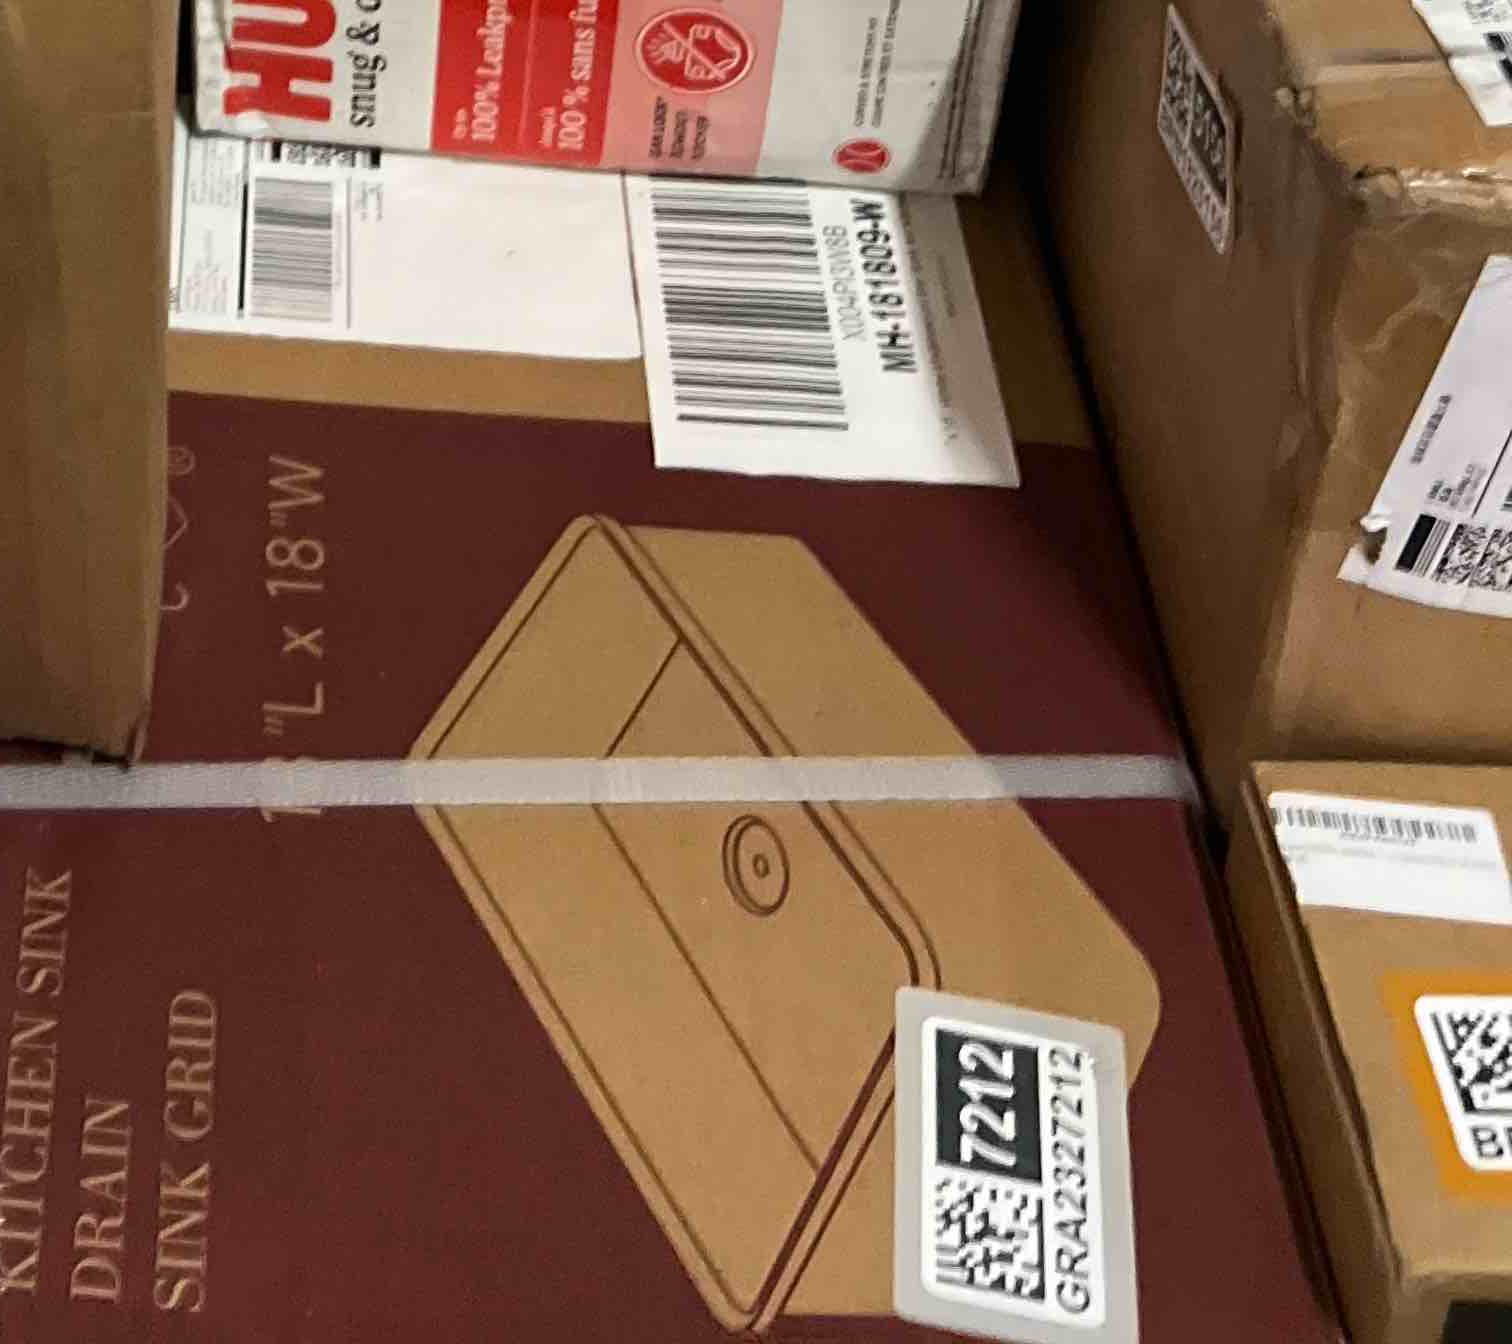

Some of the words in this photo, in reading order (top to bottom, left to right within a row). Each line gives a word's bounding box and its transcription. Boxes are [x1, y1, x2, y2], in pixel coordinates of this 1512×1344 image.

[347, 21, 380, 47] &
[349, 52, 387, 129] snug
[571, 26, 596, 81] sans
[15, 867, 73, 998] SINK
[162, 988, 219, 1142] GRID
[958, 1040, 1017, 1167] 7212
[69, 1097, 131, 1305] DRAIN
[153, 1161, 211, 1313] SINK
[1050, 1046, 1090, 1314] GRA2327212
